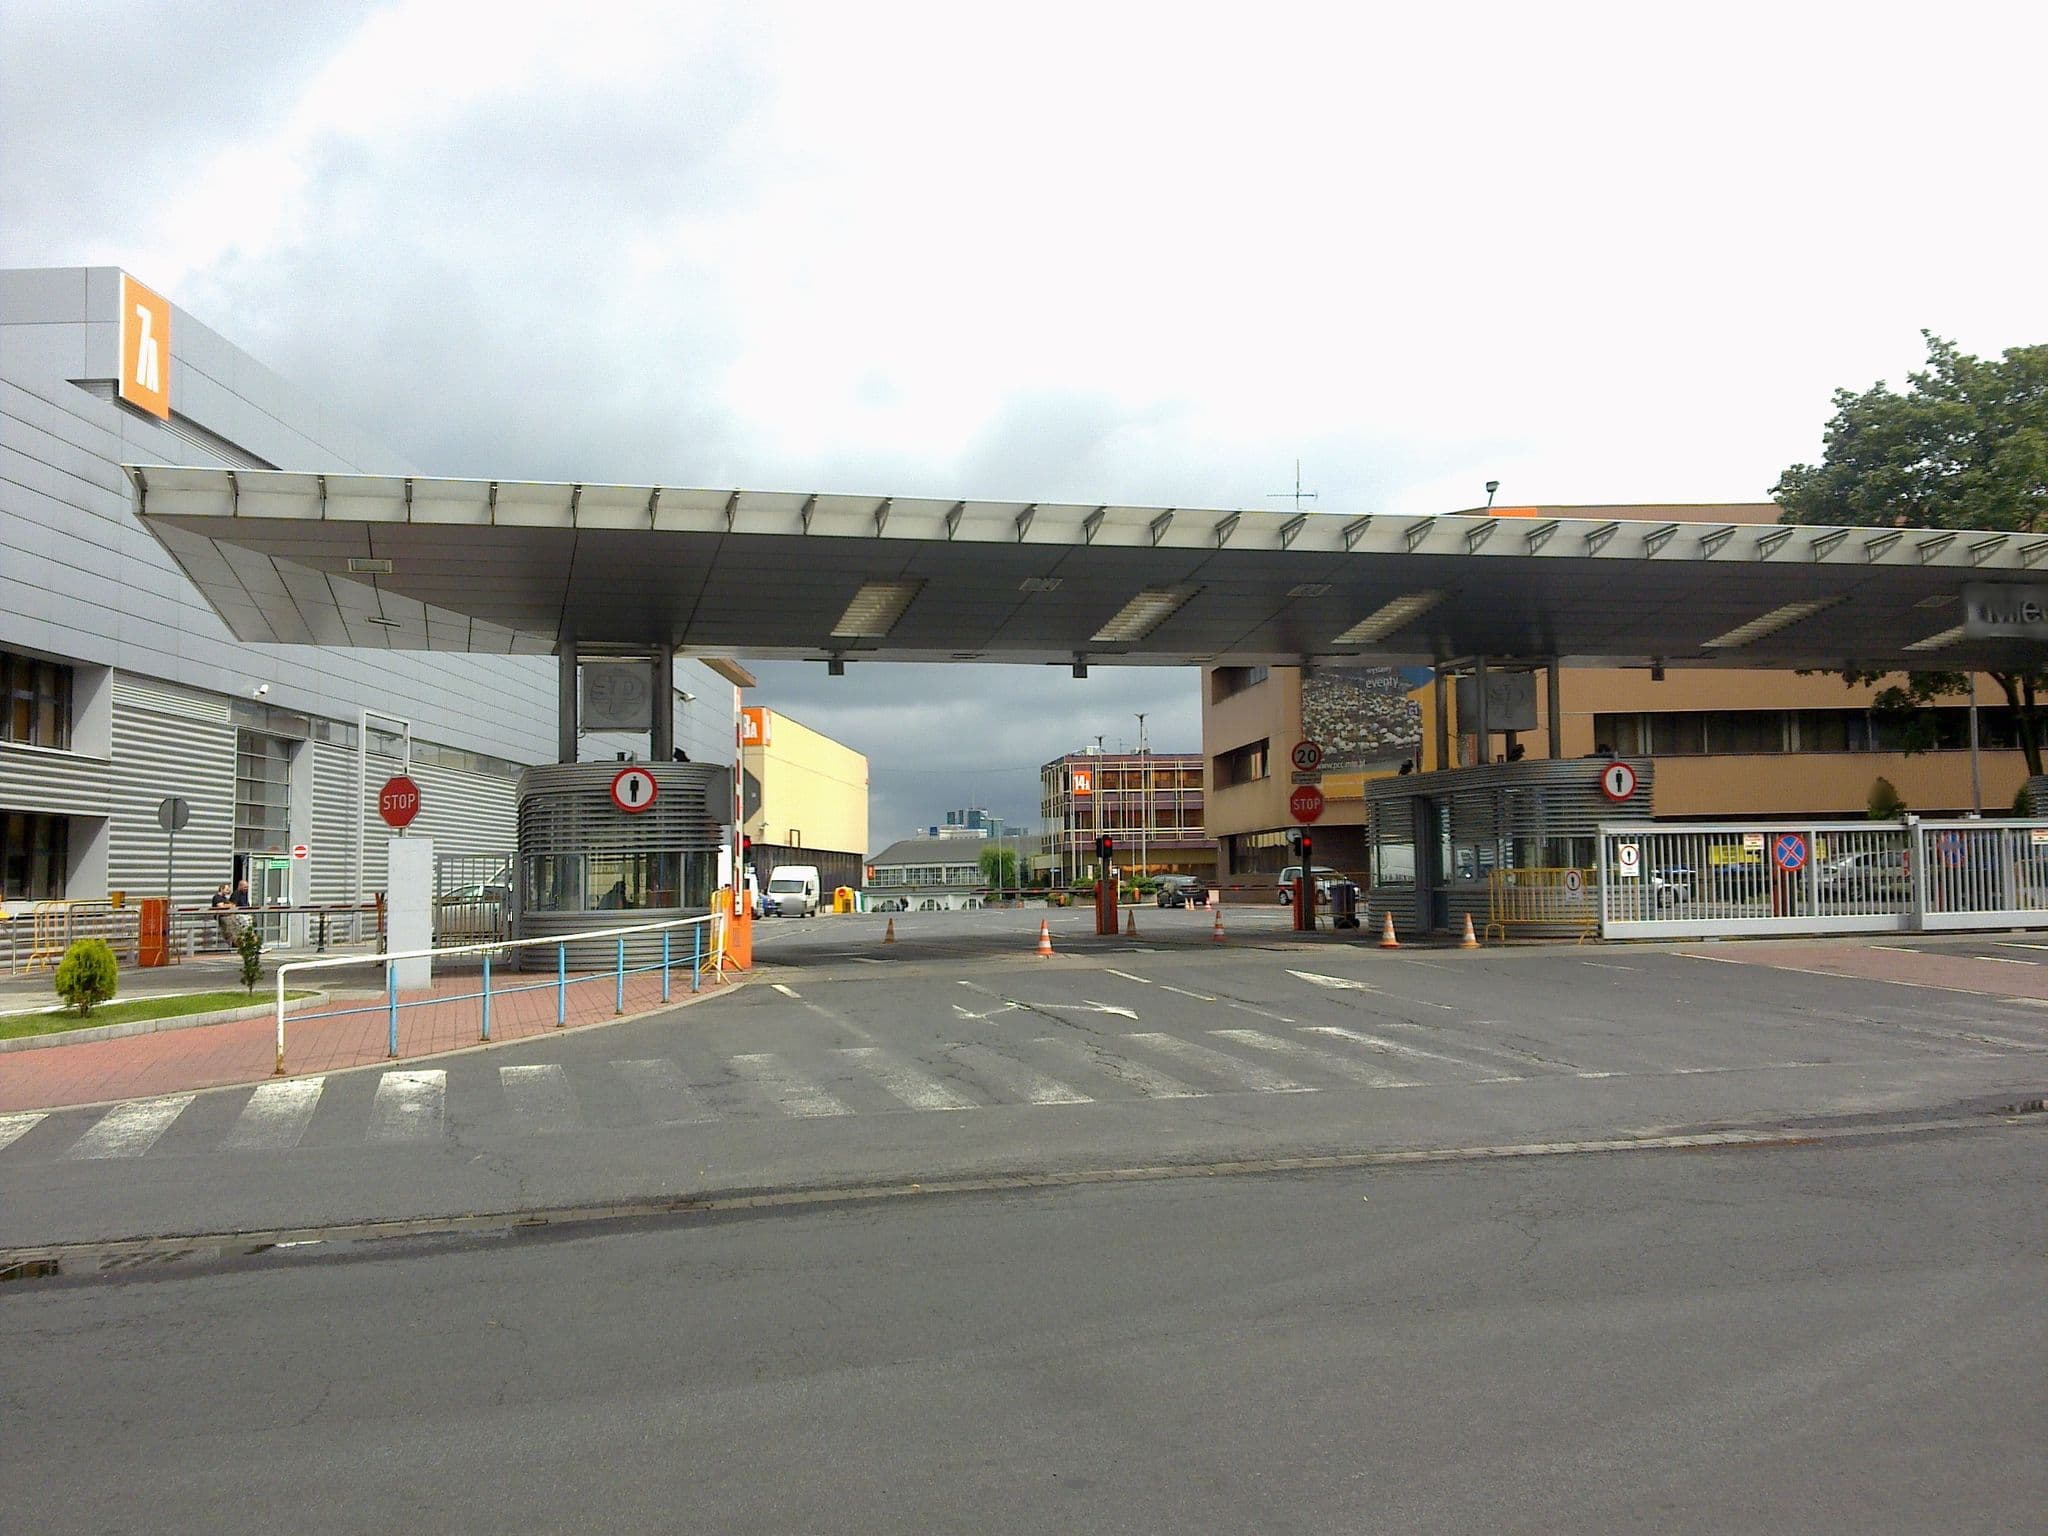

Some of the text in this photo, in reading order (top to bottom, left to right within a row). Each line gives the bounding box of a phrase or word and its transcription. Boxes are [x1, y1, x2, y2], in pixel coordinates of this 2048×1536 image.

[1297, 750, 1317, 763] 20
[384, 794, 415, 810] STOP
[1294, 799, 1320, 810] STOP
